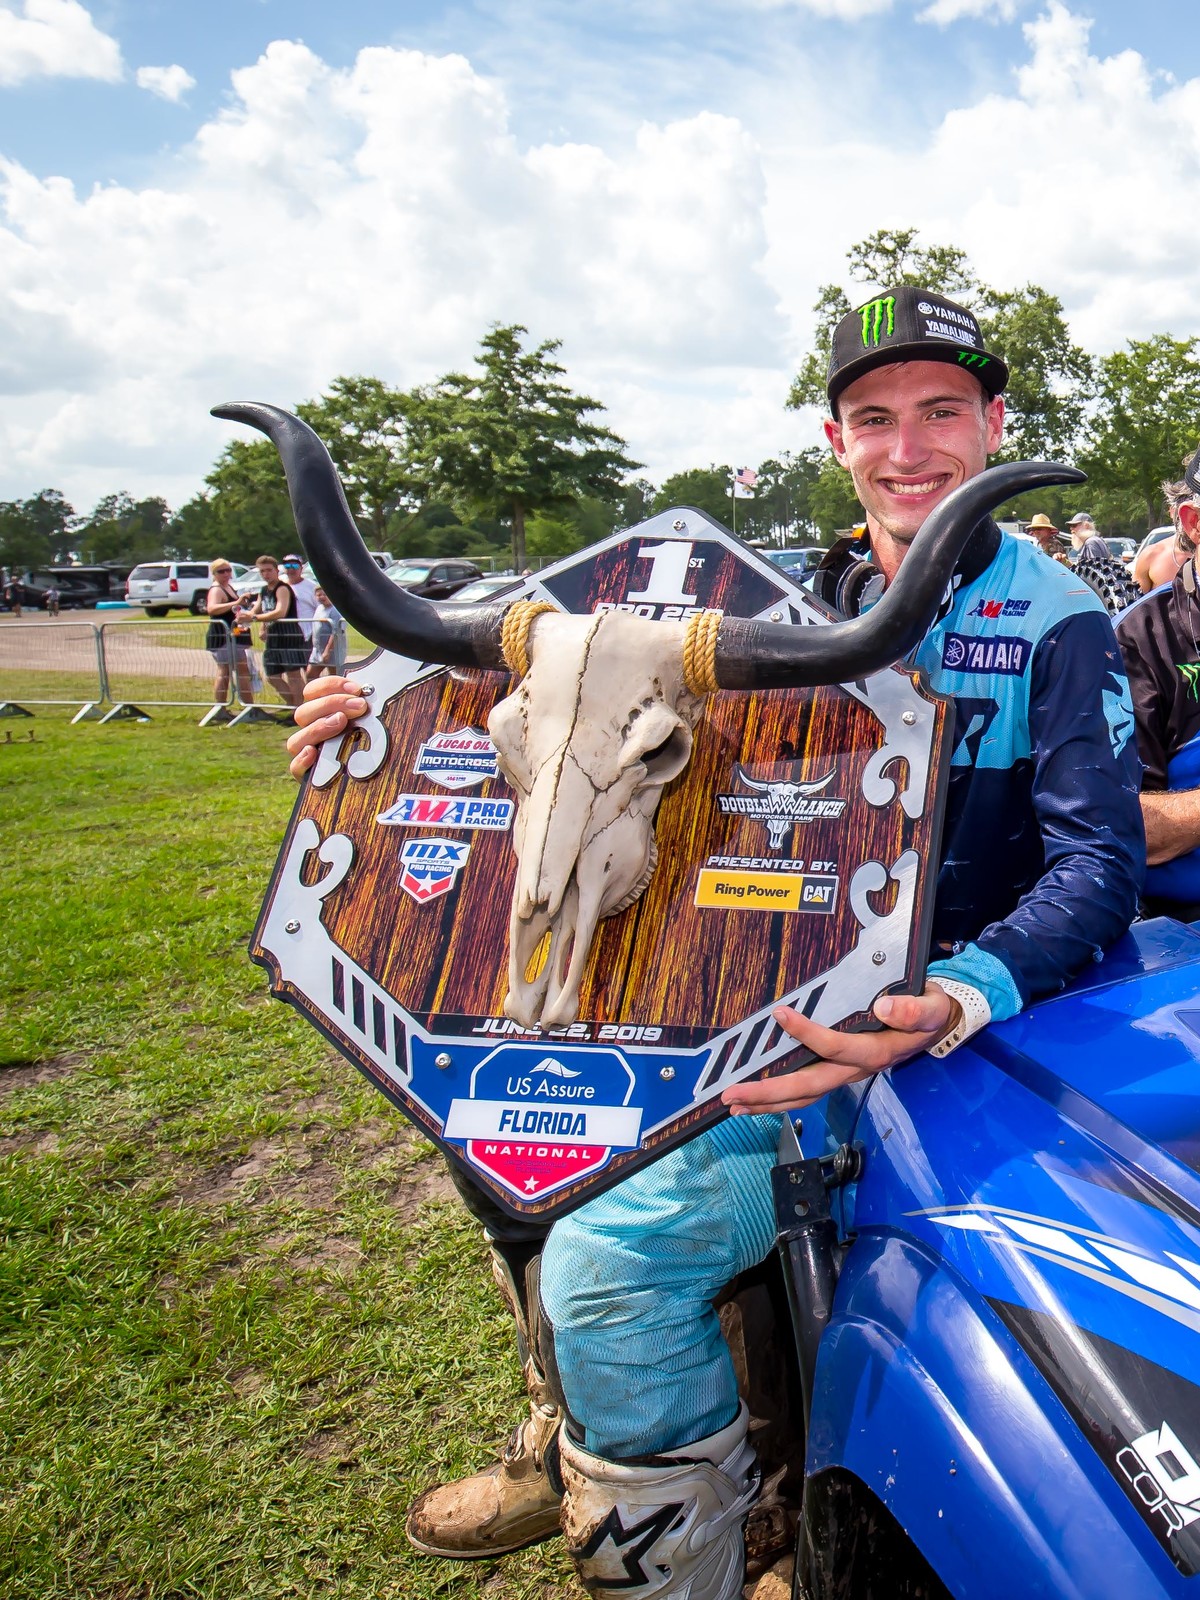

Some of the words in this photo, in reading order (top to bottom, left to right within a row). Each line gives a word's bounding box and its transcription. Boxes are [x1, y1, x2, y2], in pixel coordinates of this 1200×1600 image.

[933, 307, 976, 332] YAMAHA
[925, 320, 976, 346] YAMALUBE
[967, 599, 1003, 618] AM
[1004, 598, 1031, 610] PRO
[436, 739, 472, 749] LUCAS
[473, 741, 490, 750] OIL
[421, 756, 497, 767] MOTOCROSS
[386, 799, 465, 824] AMA
[466, 802, 511, 818] PRO
[719, 796, 770, 813] DOUBLE
[797, 799, 846, 817] RANCH
[464, 818, 507, 826] RACING
[425, 865, 452, 873] RACING
[707, 855, 804, 871] PRESENTED
[810, 861, 838, 872] BY:
[715, 883, 745, 898] Ring
[747, 885, 790, 898] Power
[803, 885, 832, 903] CAT
[598, 1025, 662, 1041] 2019
[506, 1077, 531, 1096] US
[534, 1078, 595, 1098] Assure
[499, 1109, 586, 1136] FLORIDA
[485, 1145, 590, 1159] NATIONAL
